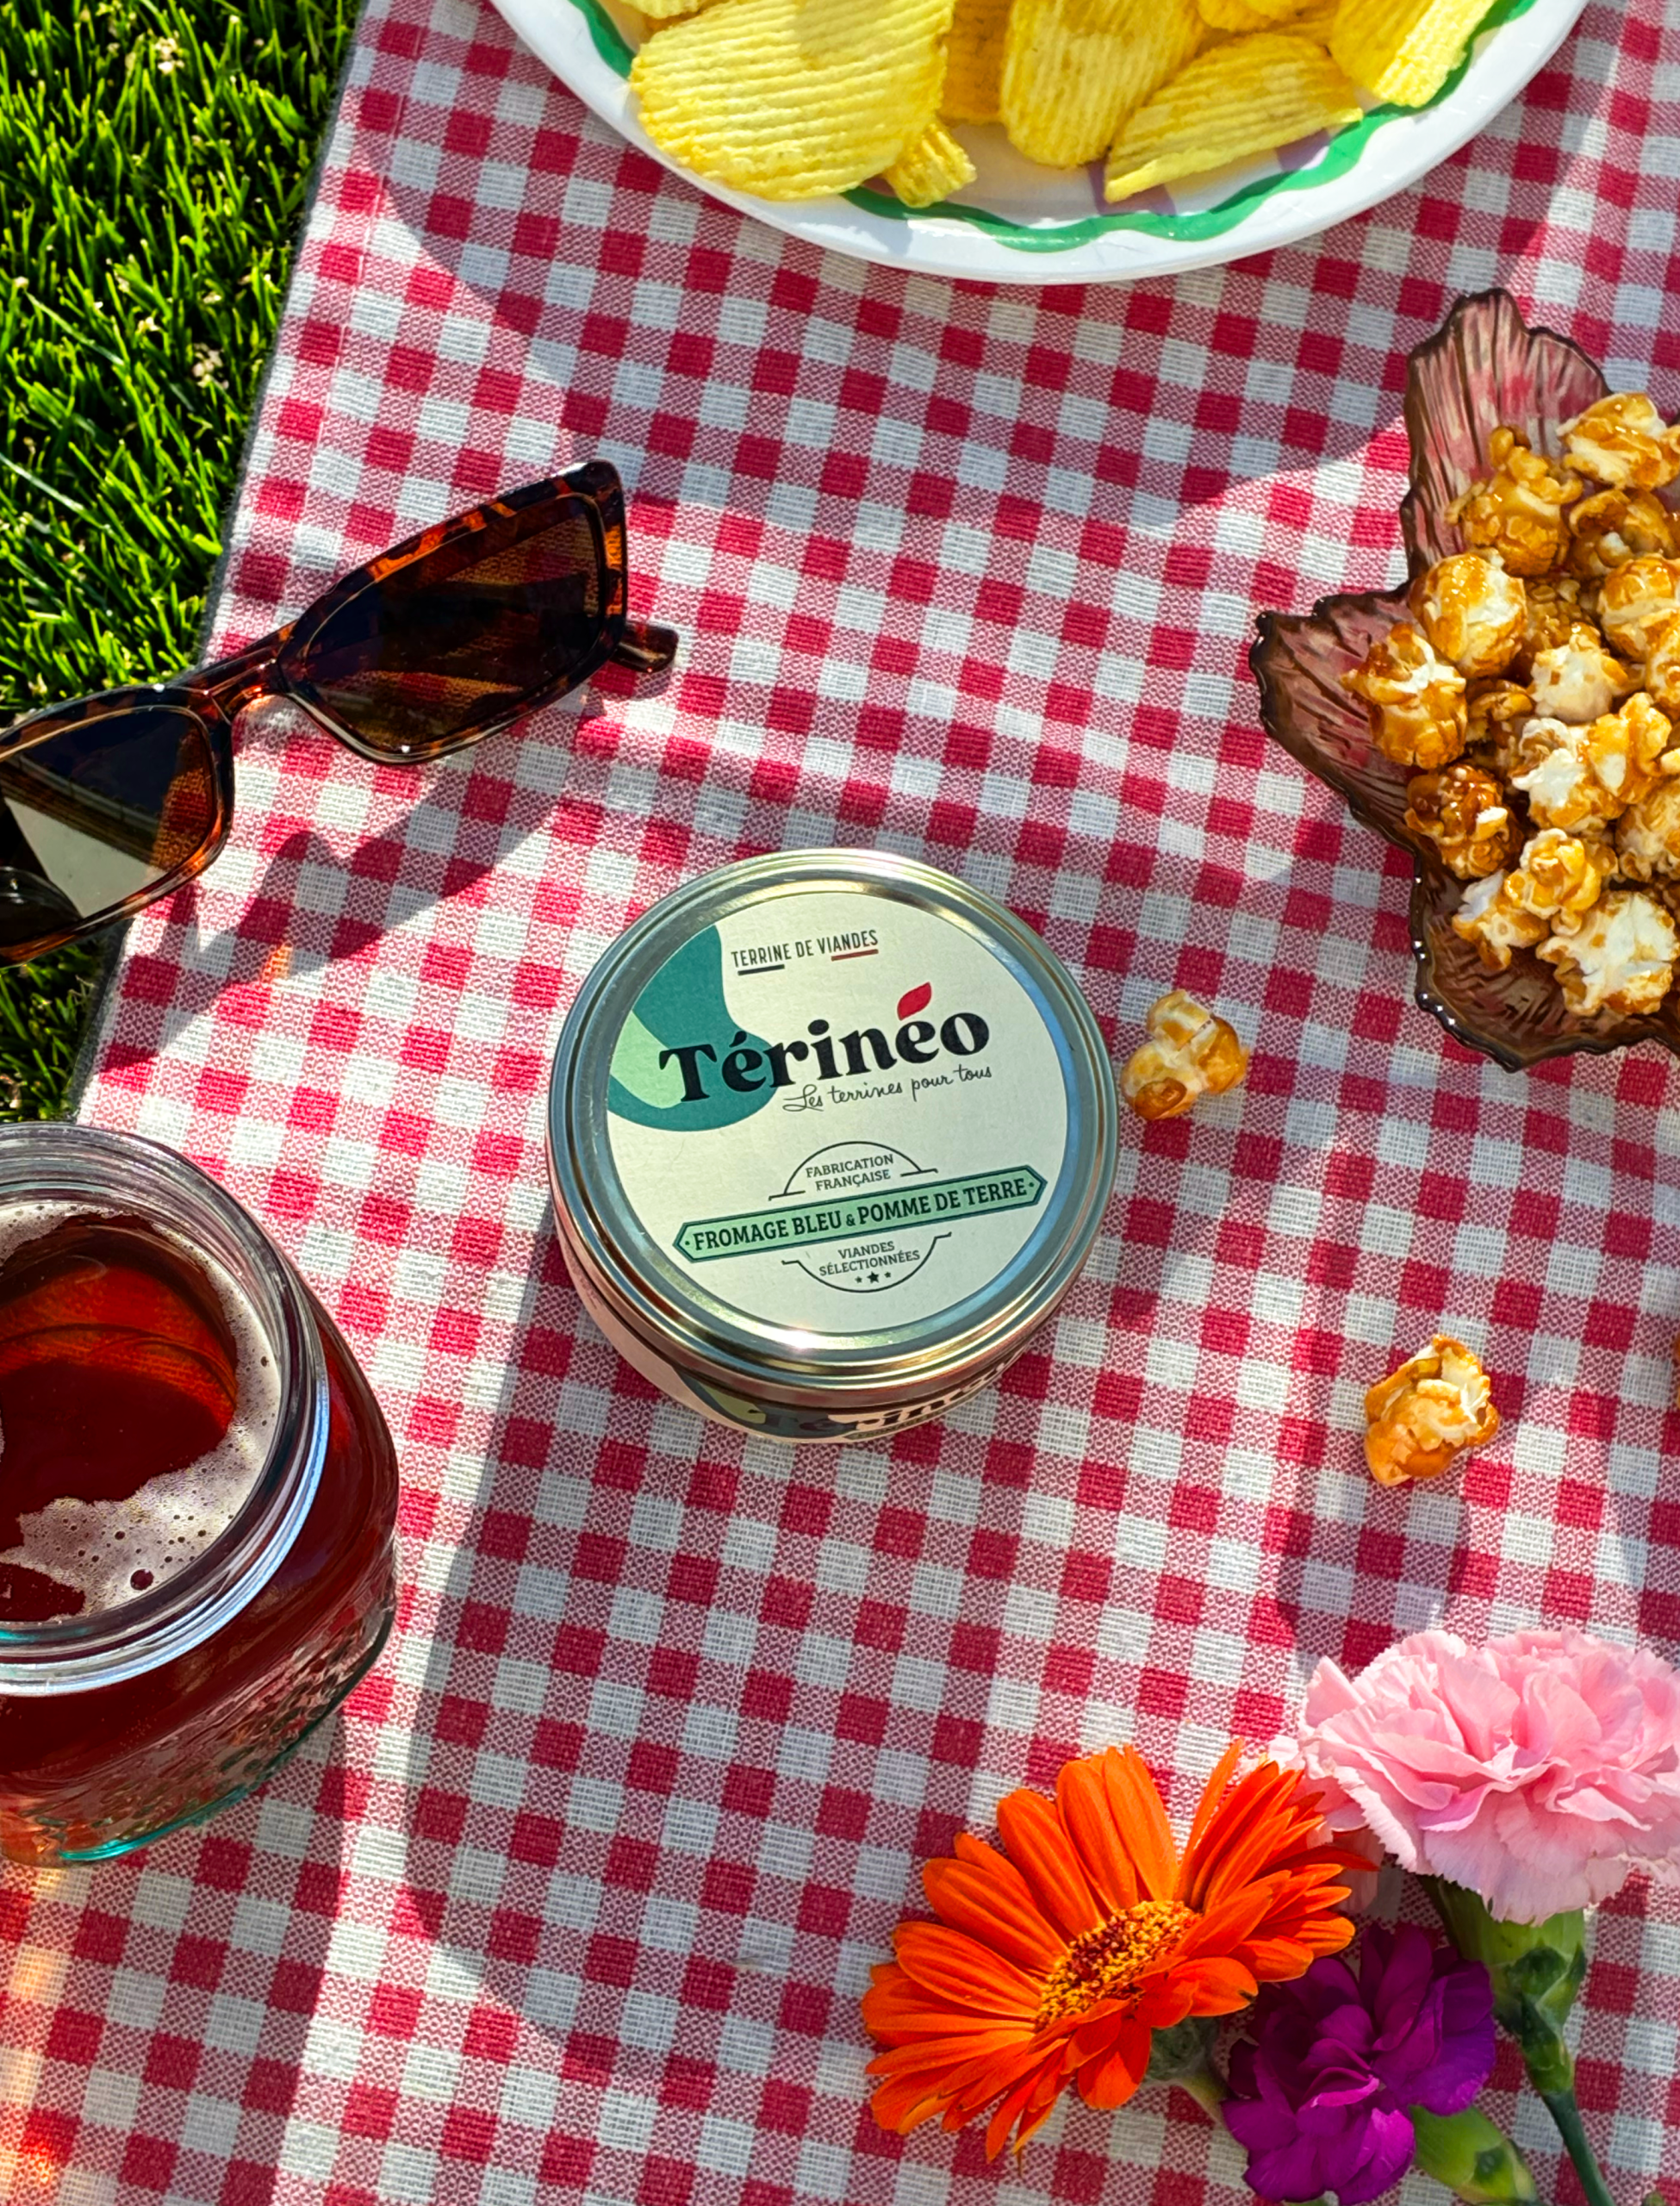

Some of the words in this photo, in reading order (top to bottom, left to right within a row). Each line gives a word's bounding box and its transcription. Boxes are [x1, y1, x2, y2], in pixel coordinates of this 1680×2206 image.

[731, 943, 792, 968] TERRINE
[794, 939, 814, 958] DE
[817, 929, 879, 954] VIANDES
[658, 981, 990, 1103] Térinéo
[782, 1084, 824, 1112] Les
[827, 1081, 903, 1104] terrines
[911, 1075, 954, 1102] pour
[953, 1063, 992, 1082] tous
[805, 1153, 894, 1178] FABRICATION
[815, 1168, 891, 1191] FRANÇAISE
[693, 1220, 789, 1250] FROMAGE
[791, 1210, 842, 1236] BLEU
[845, 1213, 856, 1227] &
[856, 1195, 932, 1225] POMME
[933, 1189, 962, 1212] DE
[963, 1177, 1028, 1206] TERRE
[818, 1249, 921, 1276] SÉLECTIONNÉES
[837, 1241, 895, 1259] VIANDES
